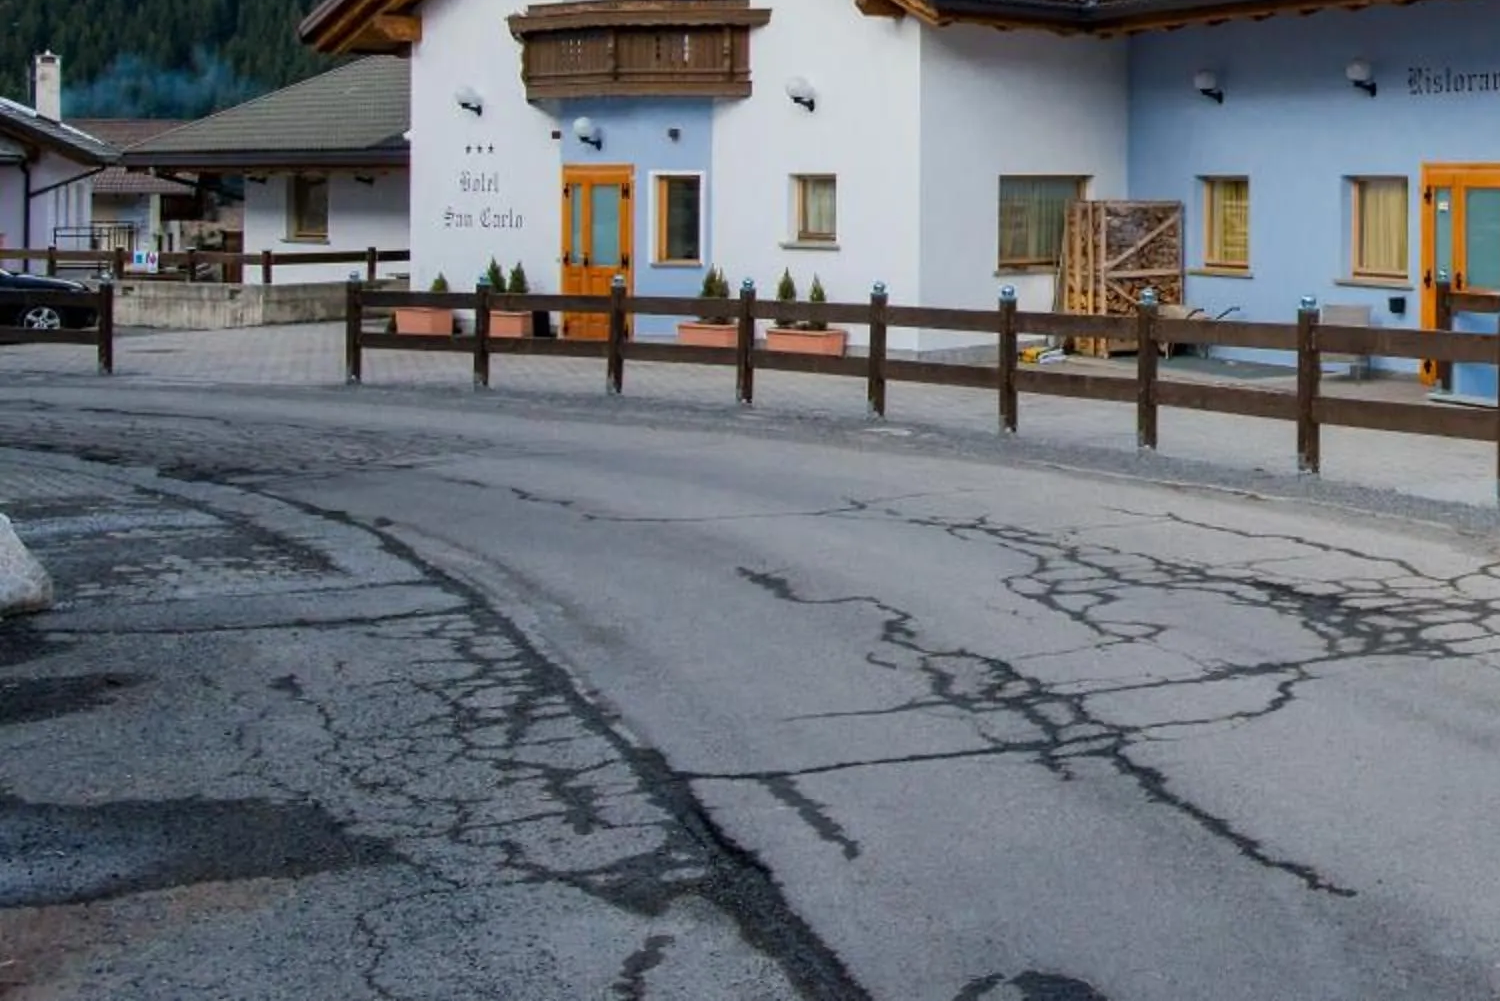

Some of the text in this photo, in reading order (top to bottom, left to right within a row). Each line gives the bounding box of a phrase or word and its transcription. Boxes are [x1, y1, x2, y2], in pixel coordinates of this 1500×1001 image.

[459, 170, 500, 193] Hotel
[444, 205, 524, 228] San Carlo
